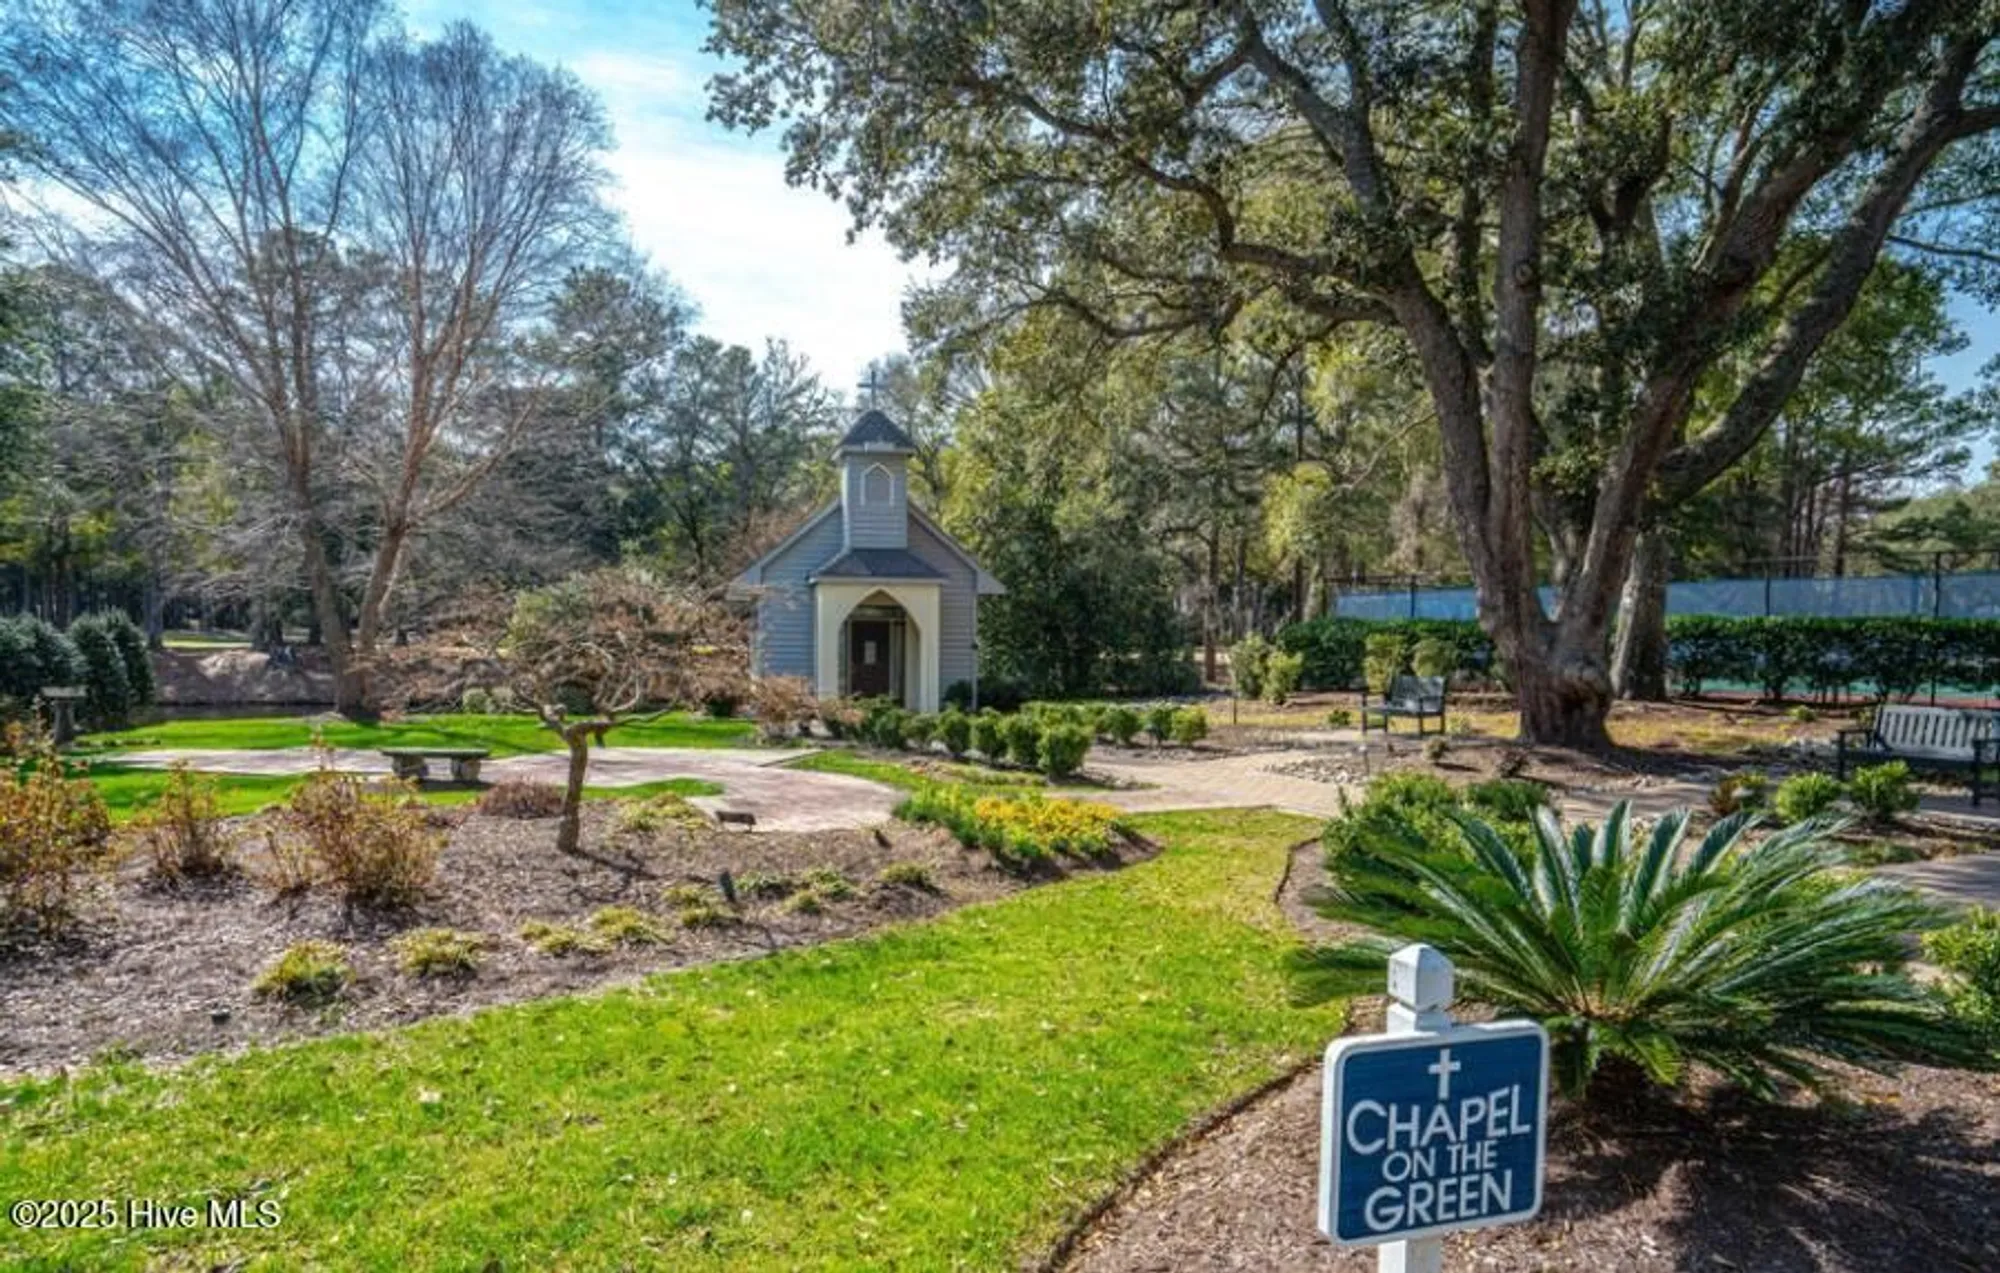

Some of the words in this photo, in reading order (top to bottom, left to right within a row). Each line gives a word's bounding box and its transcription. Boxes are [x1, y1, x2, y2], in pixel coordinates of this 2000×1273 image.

[1347, 1085, 1530, 1154] CHAPEL
[1383, 1149, 1435, 1181] ON
[1448, 1141, 1496, 1173] THE
[1366, 1170, 1511, 1230] GREEN
